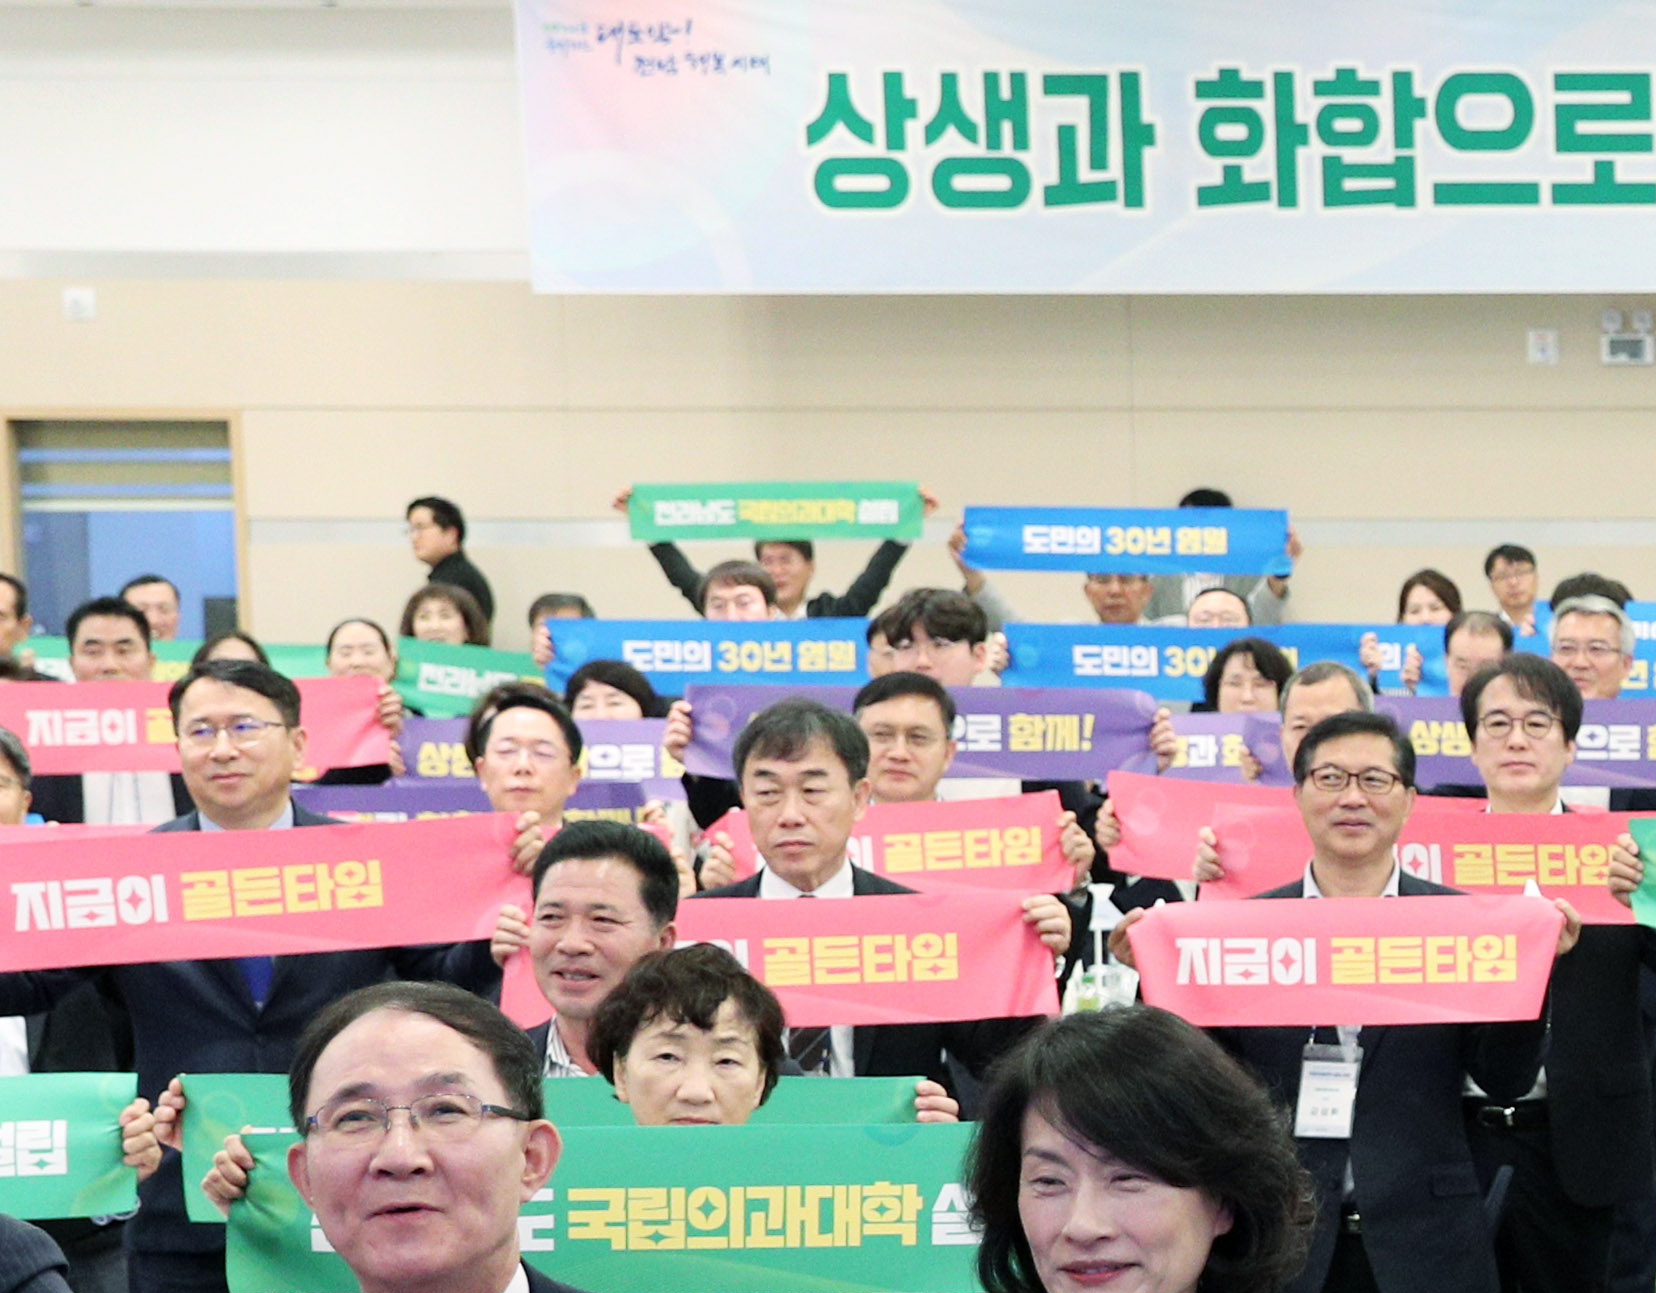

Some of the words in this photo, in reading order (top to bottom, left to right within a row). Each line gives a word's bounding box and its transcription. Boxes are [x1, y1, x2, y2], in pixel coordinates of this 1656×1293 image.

[805, 69, 1156, 209] 상생과
[1023, 524, 1102, 555] 도민의
[1105, 526, 1172, 555] 30년
[622, 639, 713, 672] 도민의
[717, 641, 793, 672] 30년
[1073, 645, 1158, 676] 도민의
[1163, 647, 1216, 677] 30
[25, 709, 138, 747] 지금이
[1009, 712, 1094, 752] 함께!
[1410, 720, 1471, 757] 상생
[1577, 724, 1642, 760] 으로
[578, 744, 656, 780] 으로
[883, 826, 1042, 873] 골든타임
[1454, 842, 1614, 886] 골든타임
[10, 875, 167, 932] 지금이
[180, 859, 384, 921] 골든타임
[763, 932, 958, 987] 골든타임
[1176, 936, 1316, 986] 지금이
[1330, 934, 1517, 986] 골든타임
[0, 1119, 68, 1179] 립
[567, 1180, 925, 1253] 국립의과대학
[931, 1183, 985, 1246] 설
